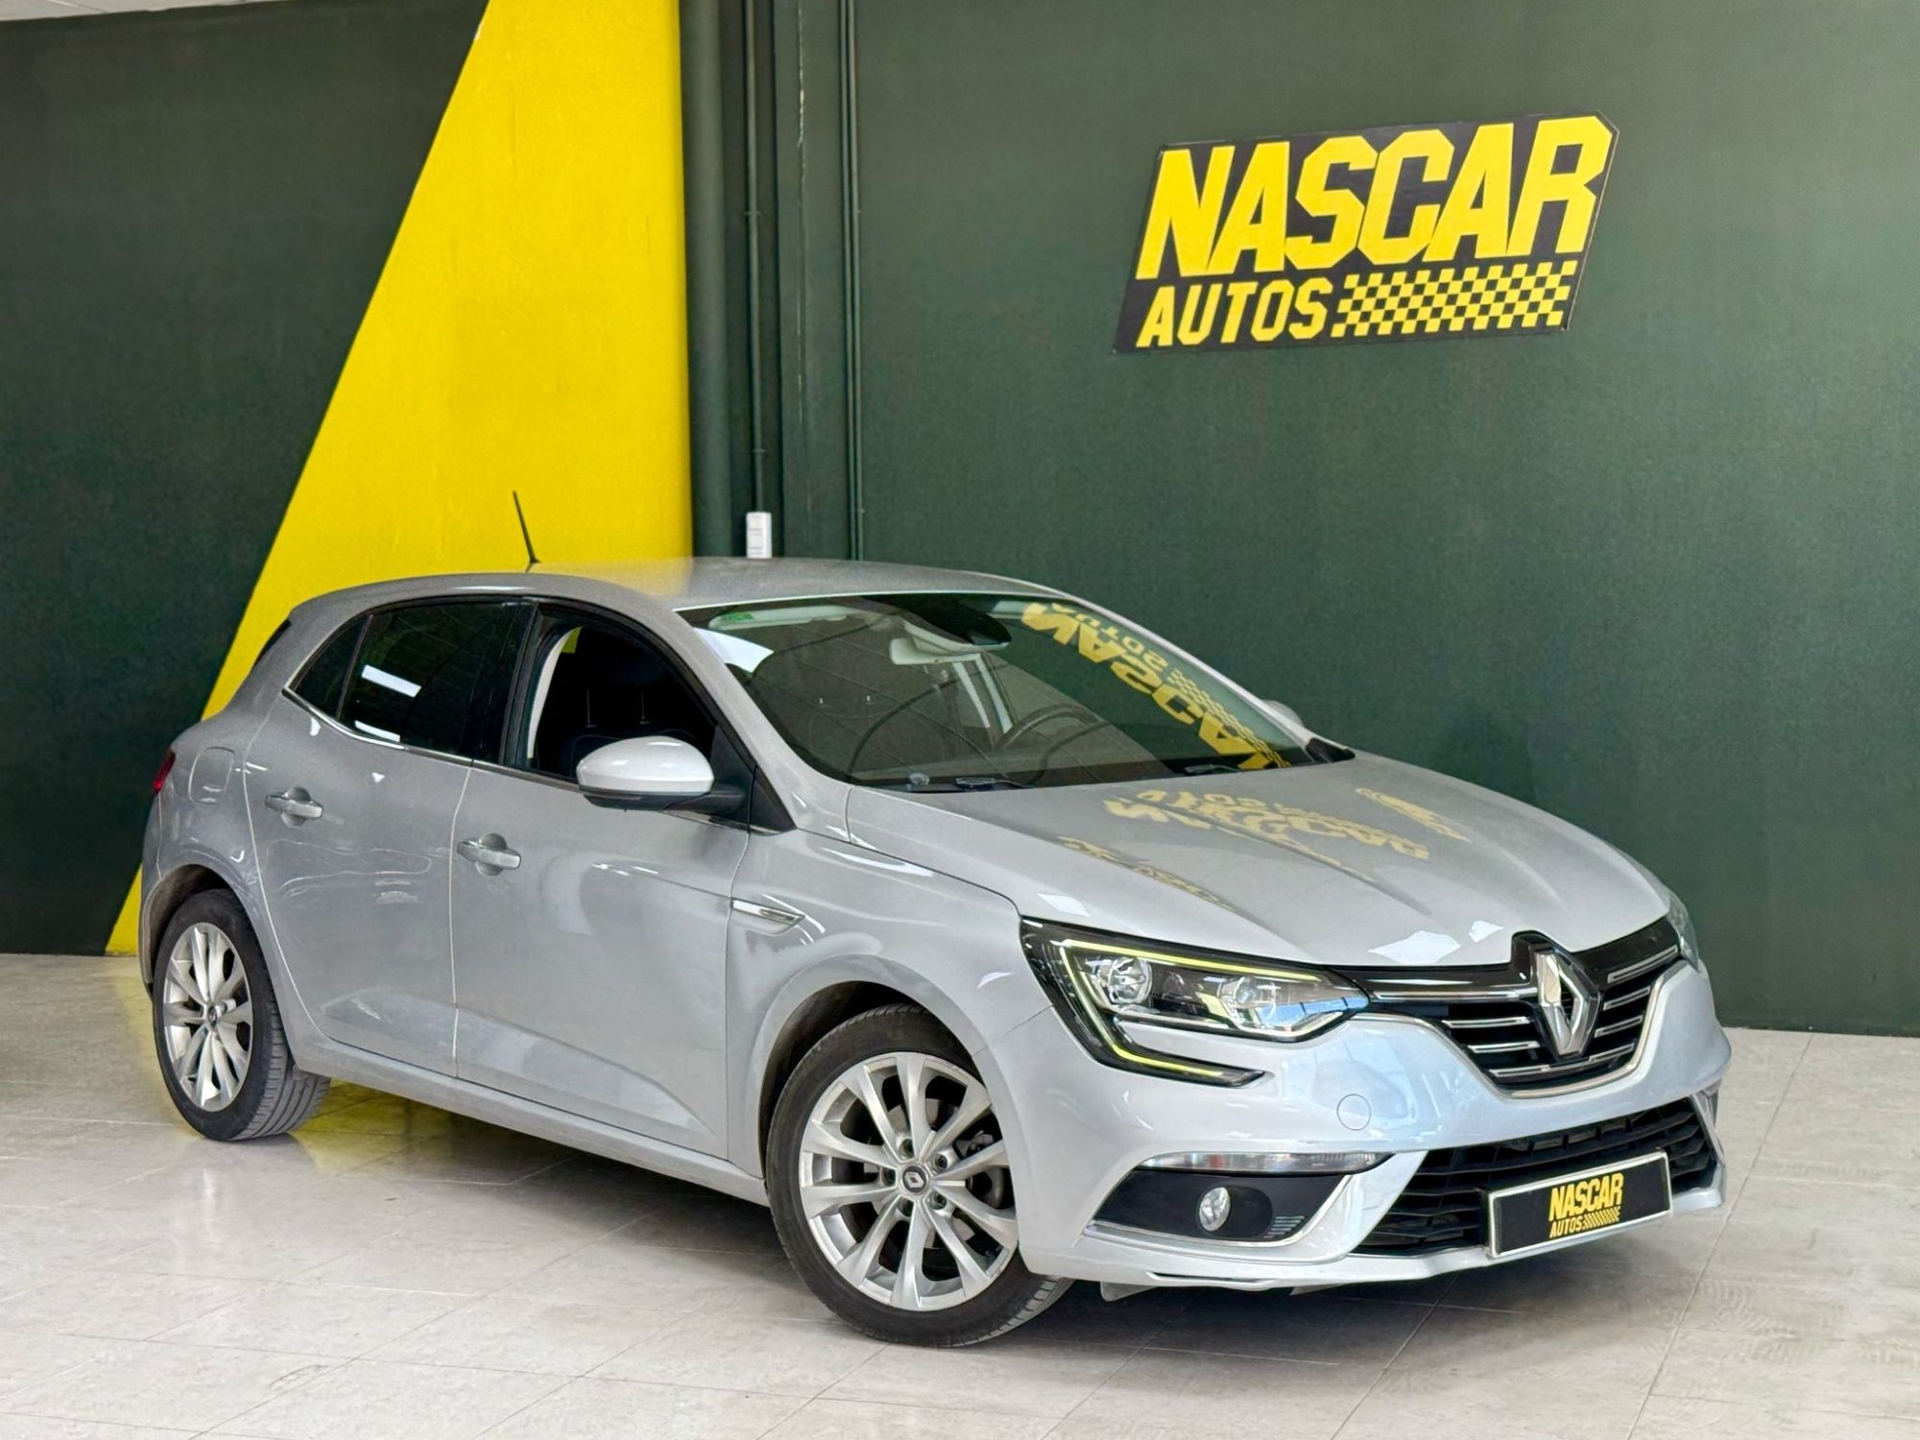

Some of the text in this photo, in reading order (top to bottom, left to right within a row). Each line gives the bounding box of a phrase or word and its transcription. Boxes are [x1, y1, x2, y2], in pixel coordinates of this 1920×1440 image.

[1135, 115, 1612, 280] NASCAR
[1135, 276, 1333, 348] AUTOS
[1549, 1172, 1624, 1222] NASCAR
[1549, 1215, 1583, 1239] AUTOS
